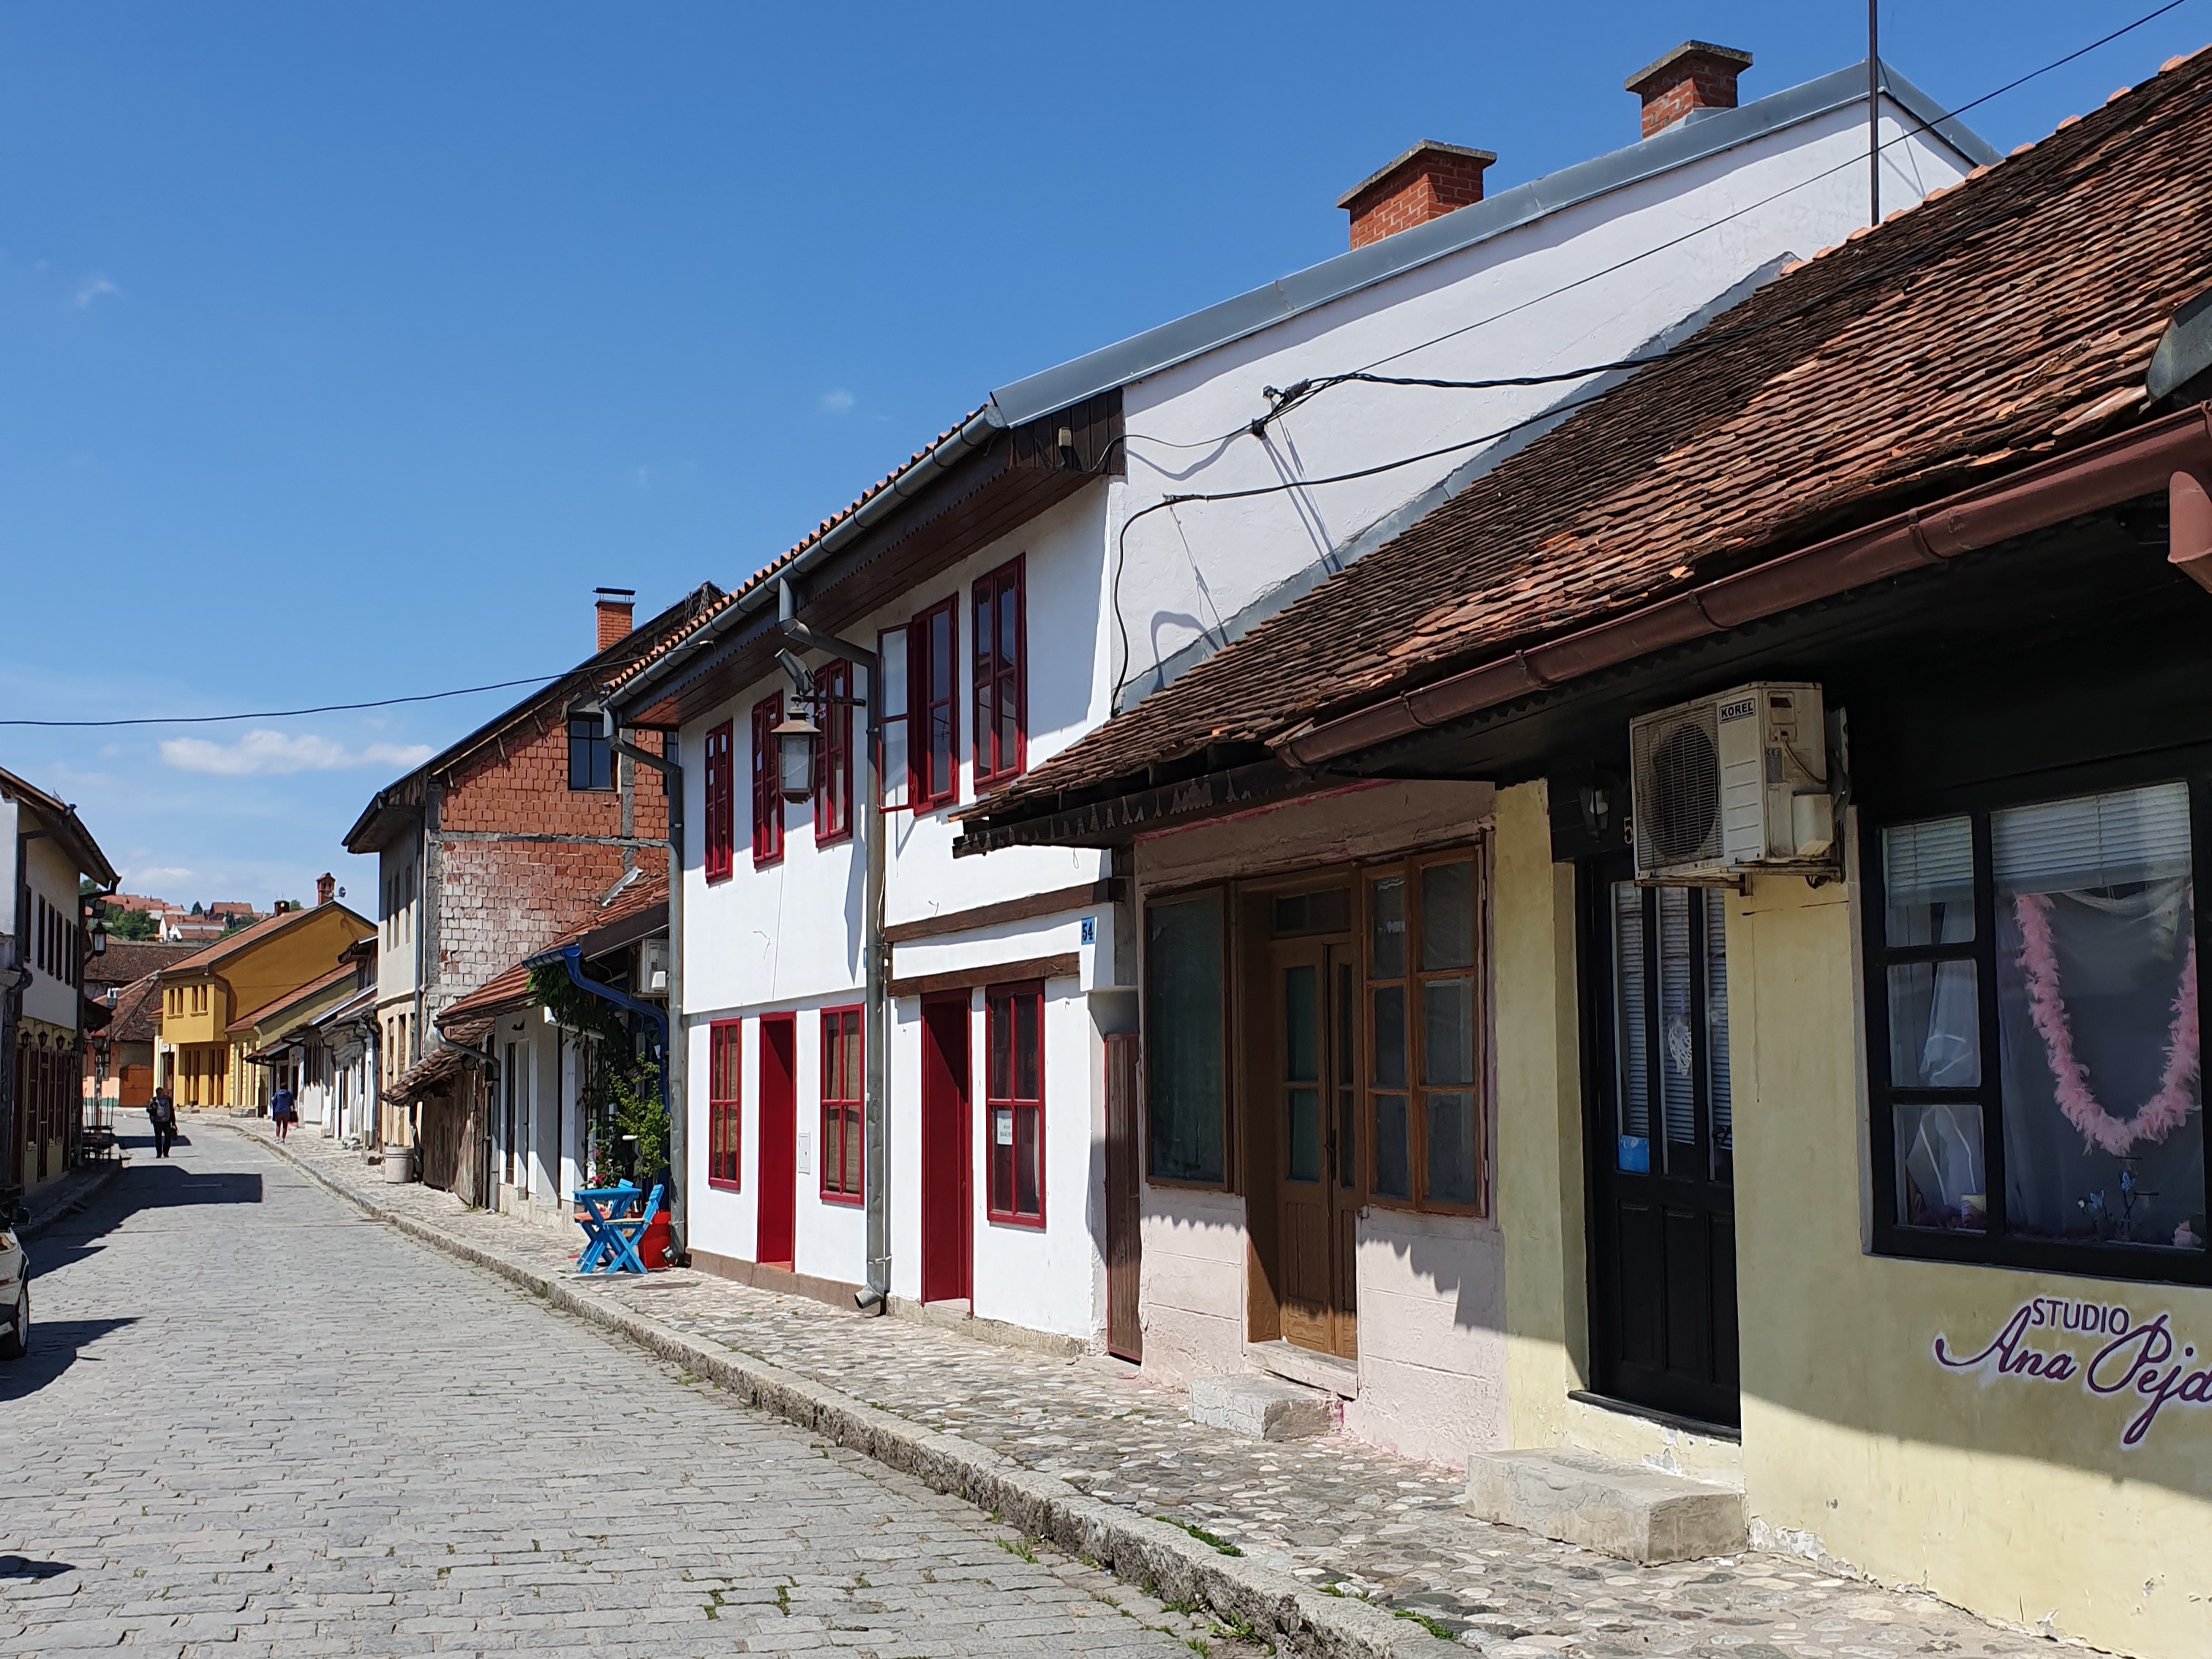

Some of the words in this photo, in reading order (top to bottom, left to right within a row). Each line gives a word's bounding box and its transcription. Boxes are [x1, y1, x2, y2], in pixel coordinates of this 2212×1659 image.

[1721, 702, 1753, 718] KOREL
[1083, 921, 1094, 941] 54
[2031, 1298, 2129, 1336] STUDIO
[1935, 1306, 2077, 1380] Ana
